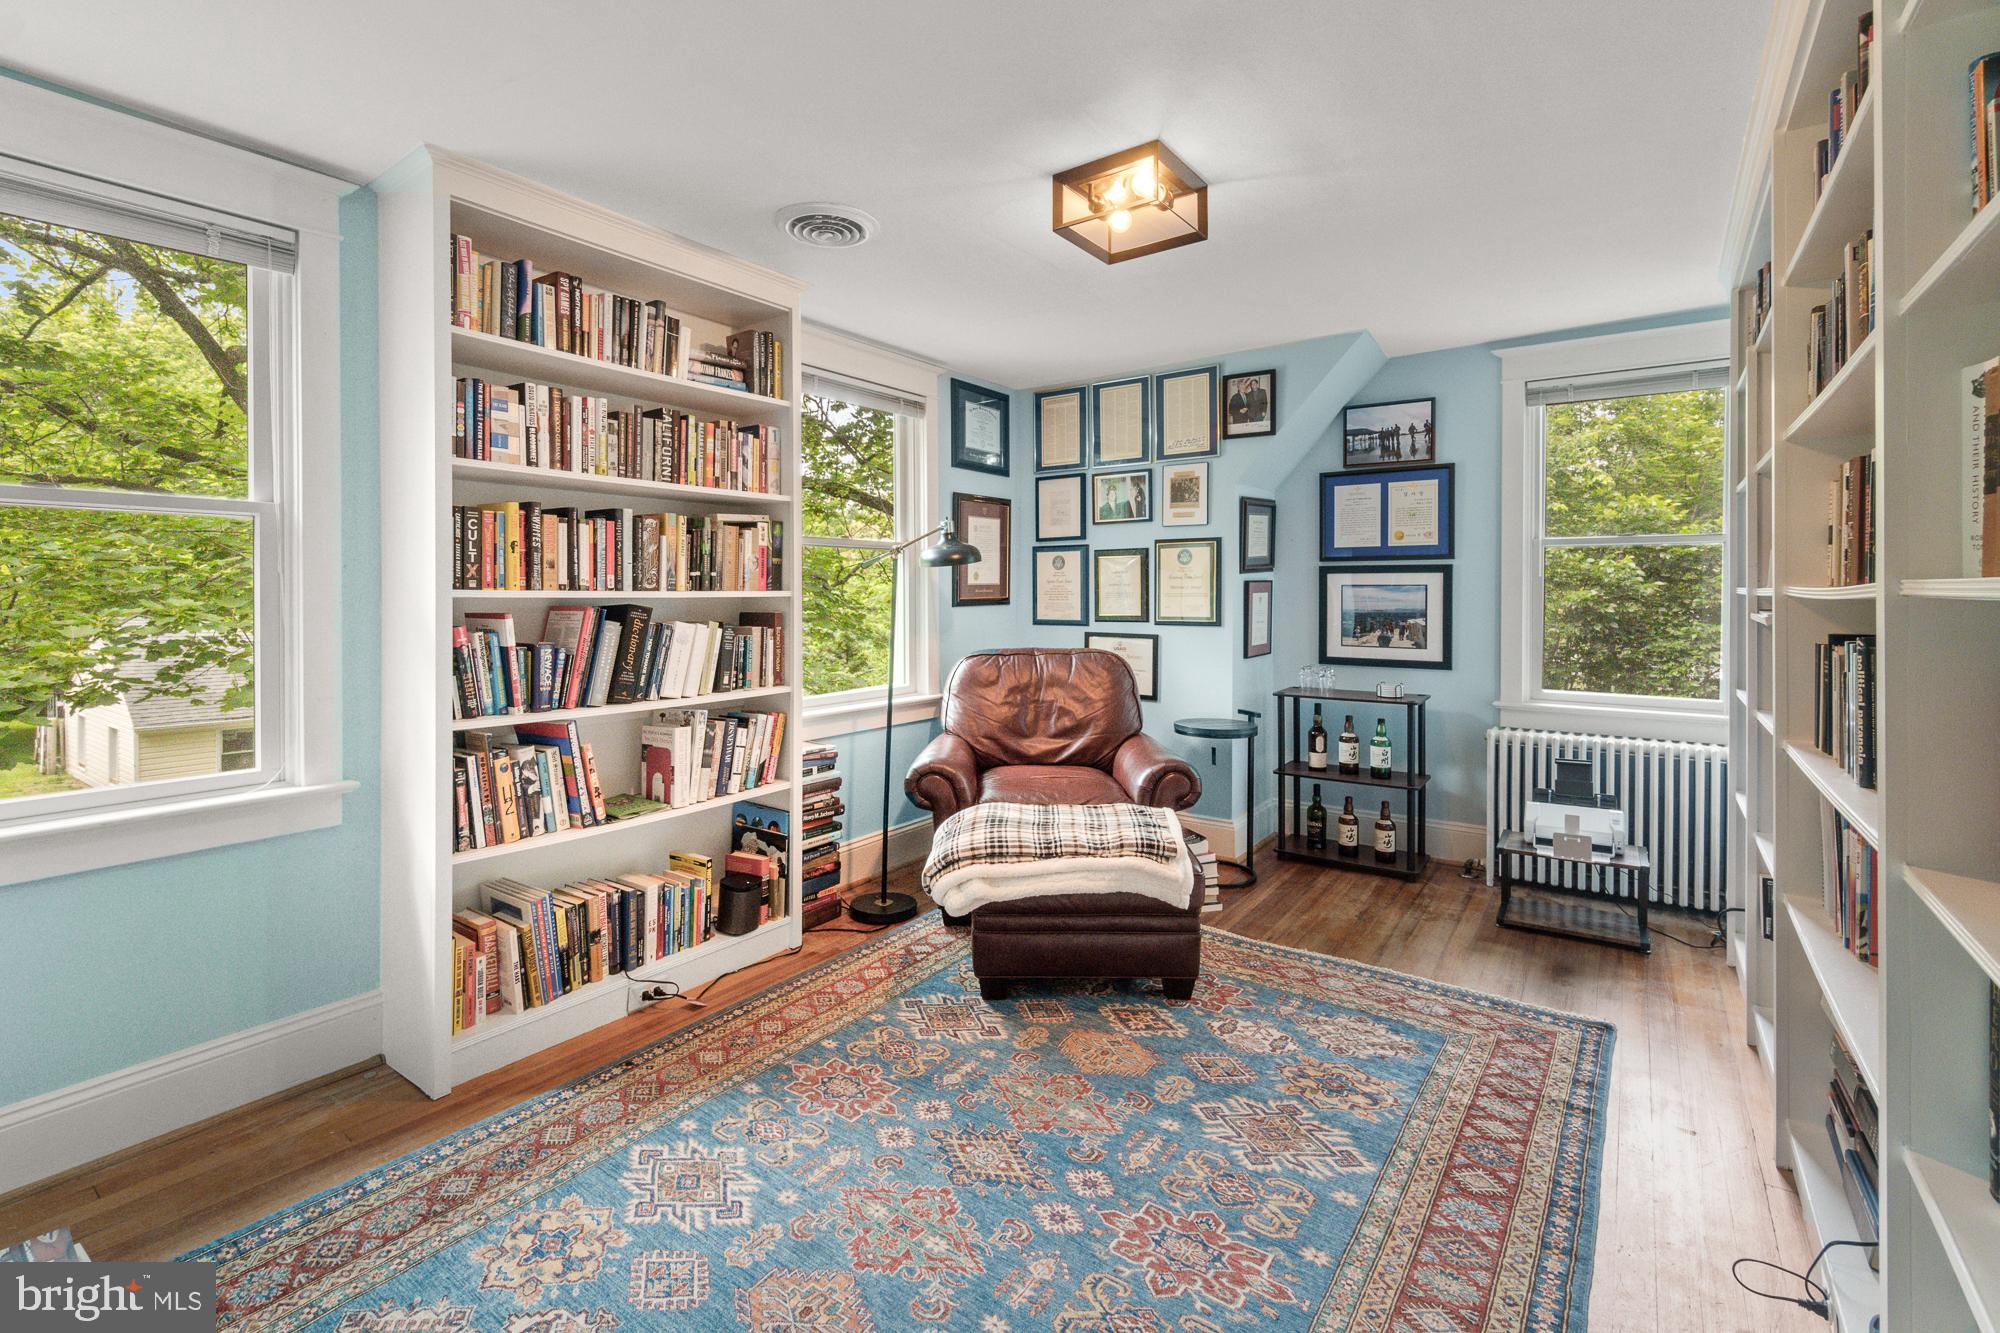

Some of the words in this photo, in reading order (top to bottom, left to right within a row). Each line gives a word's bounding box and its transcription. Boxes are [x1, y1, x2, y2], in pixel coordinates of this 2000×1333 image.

[560, 277, 569, 291] SPY
[560, 292, 570, 315] GAMES
[528, 385, 536, 401] DAVID
[528, 402, 536, 426] IGNATIUS
[1972, 406, 1980, 432] AND
[529, 427, 537, 463] BLOODMONEY
[1972, 433, 1980, 470] THEIR
[1971, 474, 1980, 525] HISTORY
[467, 519, 478, 563] CULT
[532, 516, 541, 548] WHITES
[466, 563, 479, 578] X
[544, 648, 552, 668] NEW
[544, 668, 552, 688] AGE
[1857, 655, 1865, 706] political
[724, 721, 736, 763] DISNEYWAR
[1857, 709, 1865, 765] paranoia
[1346, 827, 1356, 842] 山崎
[1383, 833, 1393, 848] 山崎
[599, 895, 607, 932] MONEYBALL
[547, 944, 552, 954] DE
[485, 934, 499, 991] BASKETBALL
